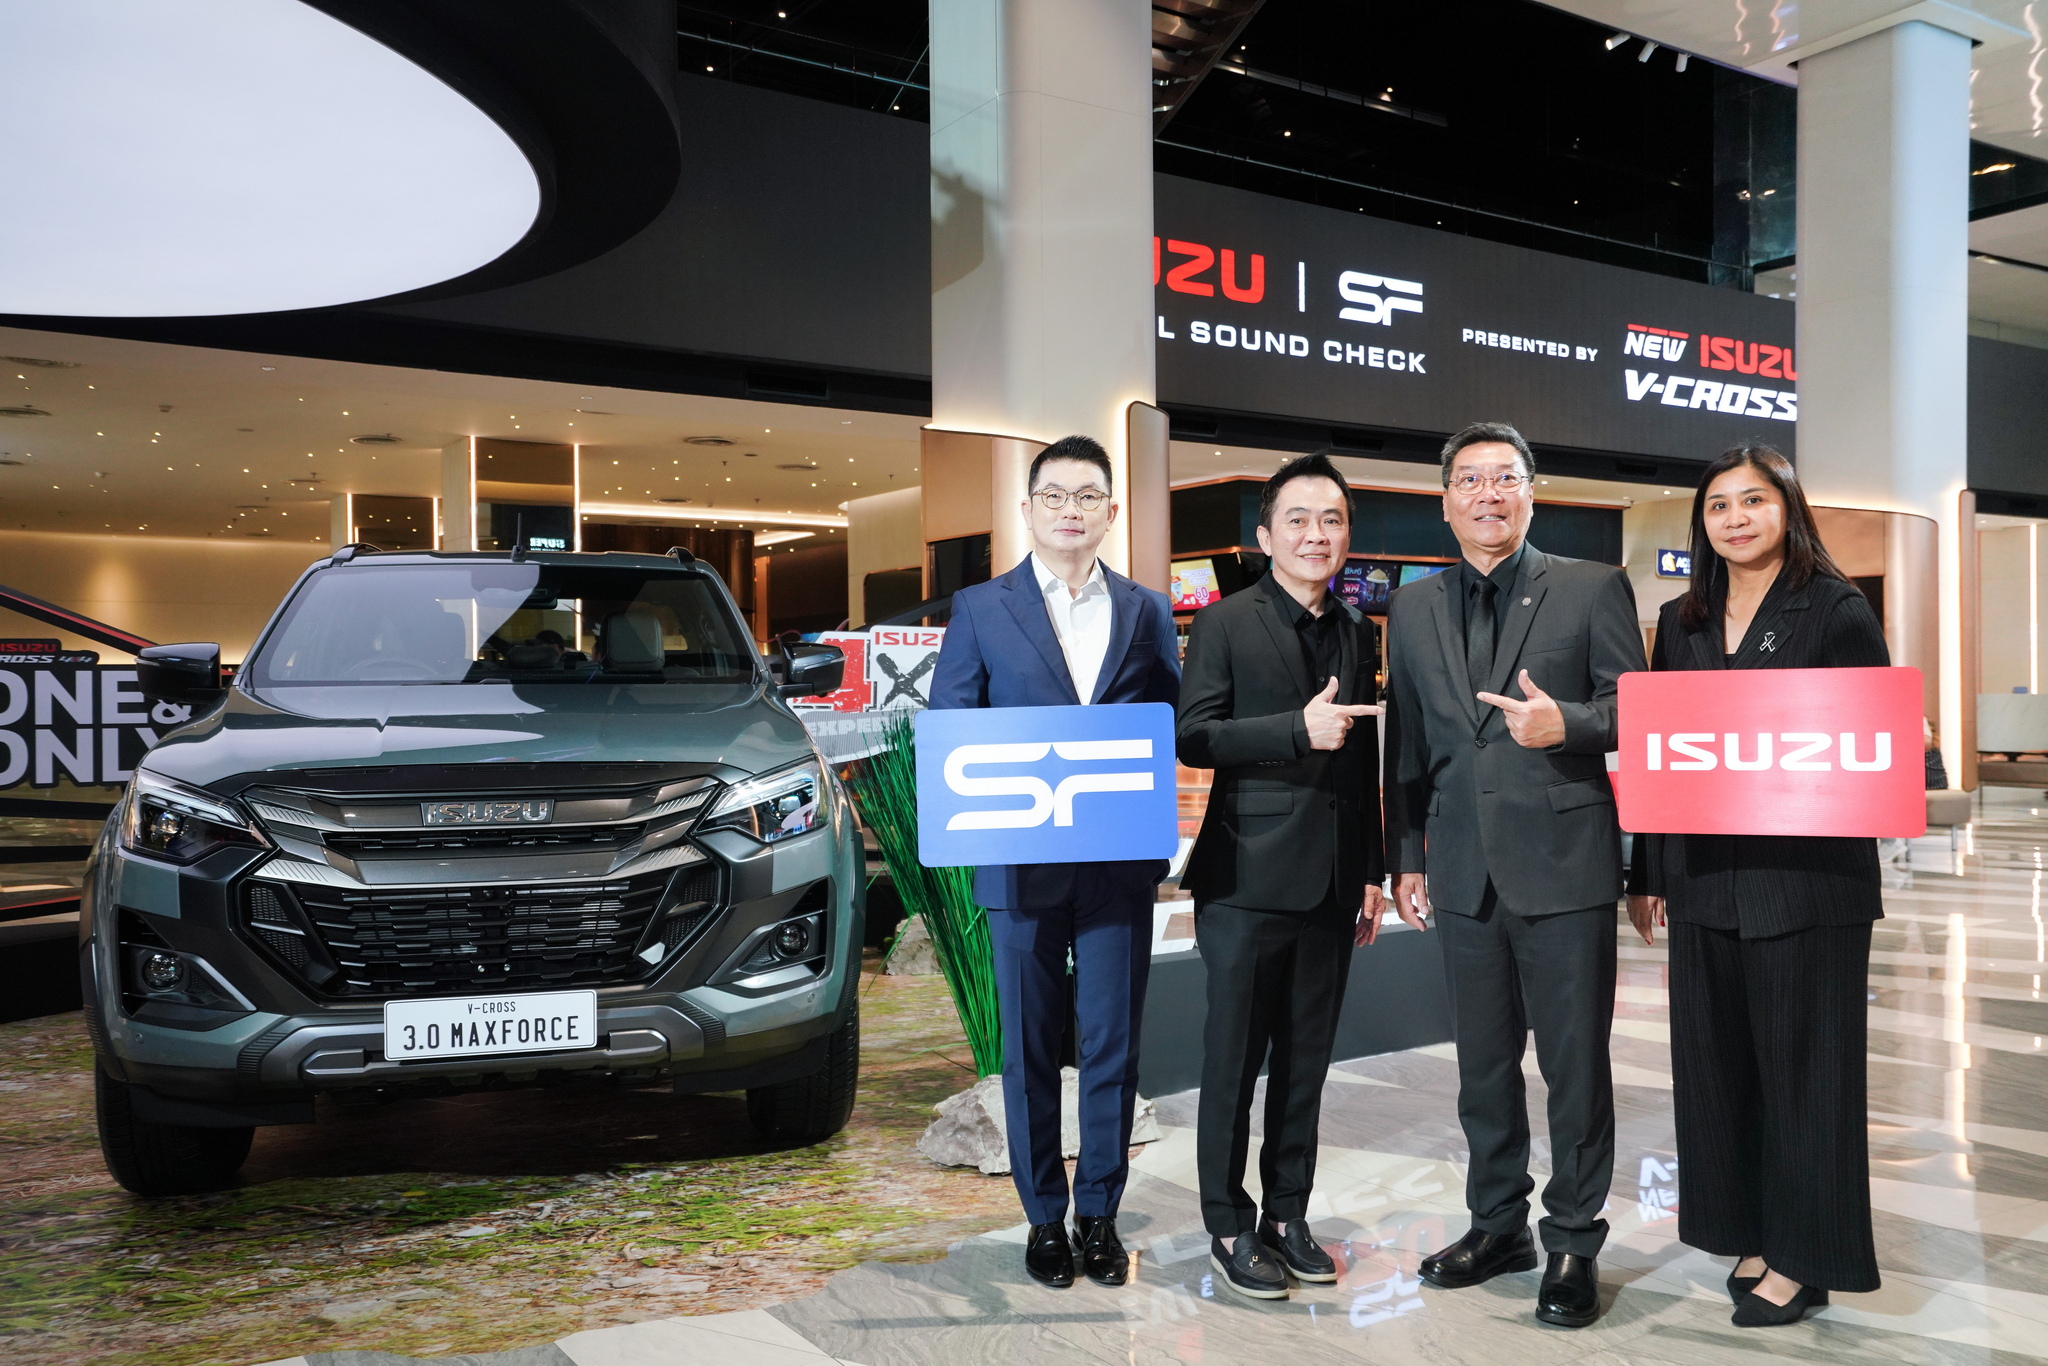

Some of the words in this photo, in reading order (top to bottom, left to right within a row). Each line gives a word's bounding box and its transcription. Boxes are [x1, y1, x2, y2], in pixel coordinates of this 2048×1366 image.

[1153, 236, 1265, 304] ZU
[1338, 270, 1424, 326] SF
[1190, 320, 1310, 358] SOUND
[1323, 340, 1427, 374] CHECK
[1462, 328, 1570, 358] PRESENTED
[1575, 346, 1599, 361] BY
[1624, 331, 1687, 362] NEW
[1624, 369, 1798, 422] V-CROSS
[0, 643, 57, 652] ISUZU
[875, 632, 944, 646] ISUZ
[1646, 732, 1892, 773] ISUZU
[943, 738, 1154, 831] SF
[427, 802, 547, 824] ISUZU
[467, 1001, 516, 1015] V-CROSS
[403, 1023, 440, 1051] 3.0
[450, 1015, 579, 1048] MAXFORCE
